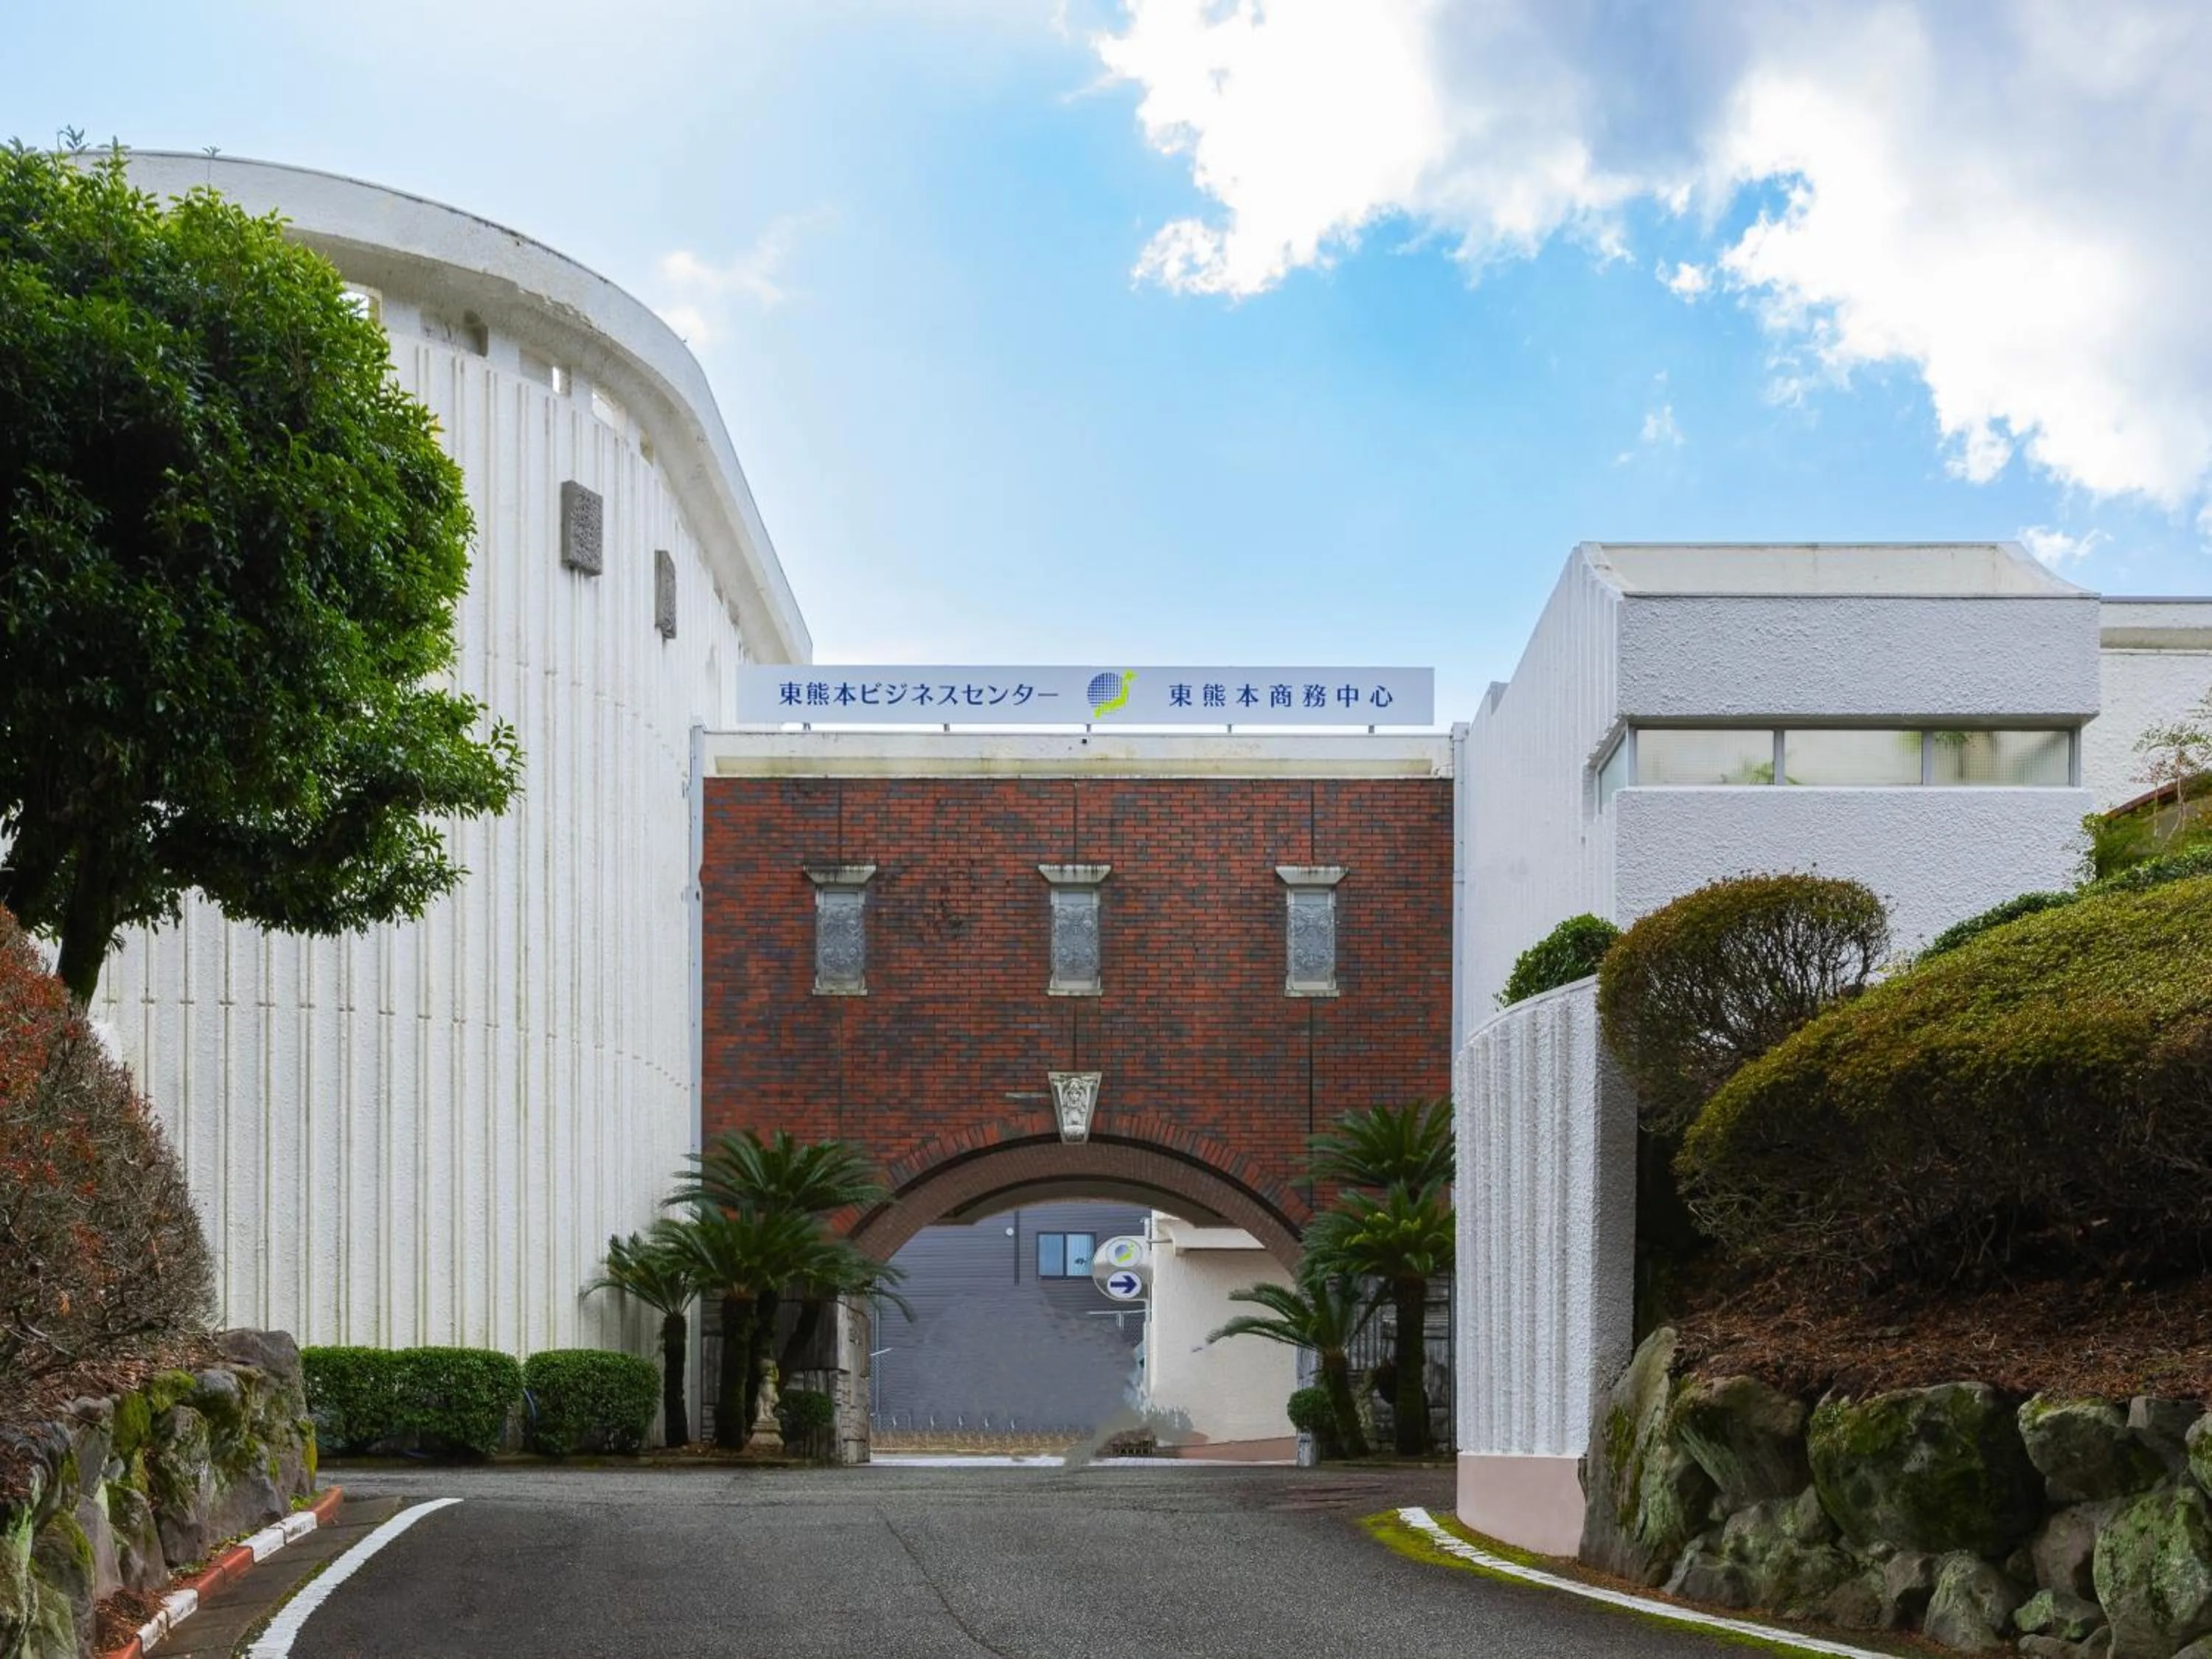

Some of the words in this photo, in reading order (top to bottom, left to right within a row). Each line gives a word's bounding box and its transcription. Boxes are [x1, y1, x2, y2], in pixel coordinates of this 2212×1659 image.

[779, 681, 1058, 706] 東熊本ビジネスセンター
[1169, 684, 1393, 708] 東熊本商務中心
